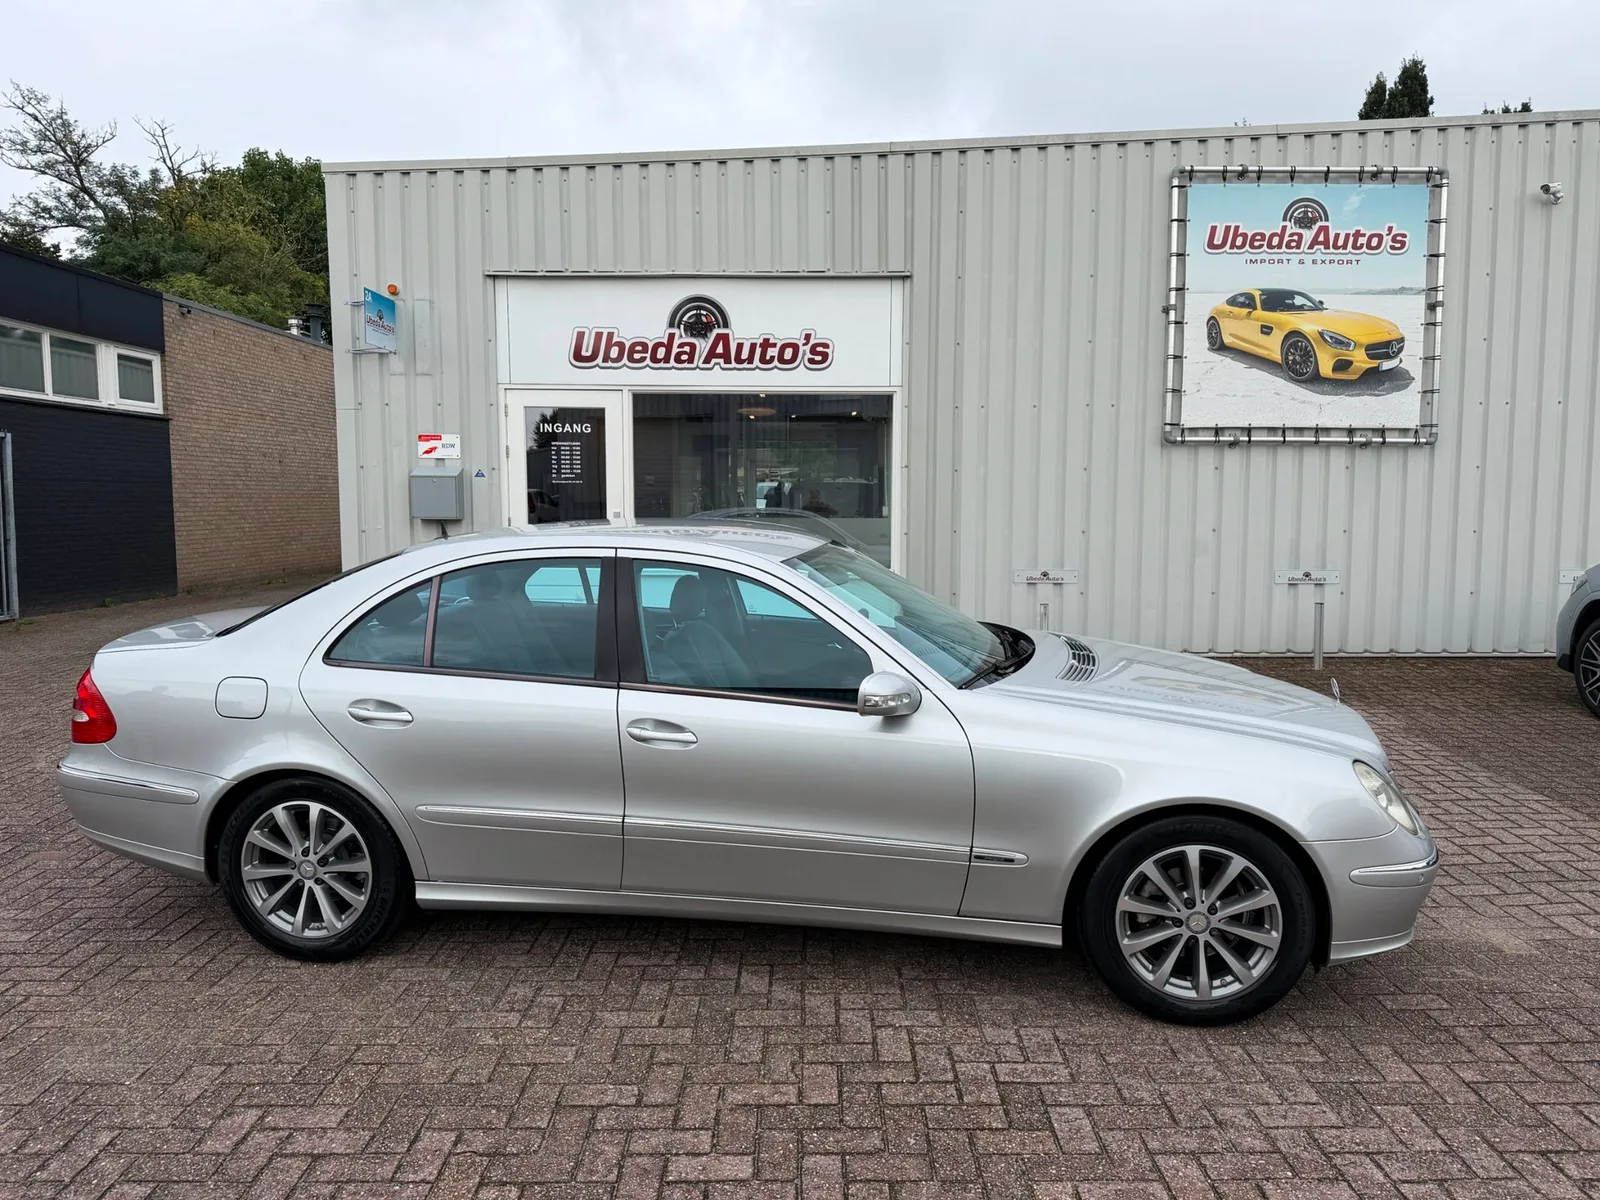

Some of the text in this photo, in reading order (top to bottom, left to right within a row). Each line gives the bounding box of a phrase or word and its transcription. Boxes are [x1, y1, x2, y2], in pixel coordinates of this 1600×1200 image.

[1206, 224, 1408, 251] Ubeda Auto's
[365, 290, 373, 303] 2A
[571, 329, 831, 366] Ubeda Auto's
[540, 422, 592, 433] INGANG
